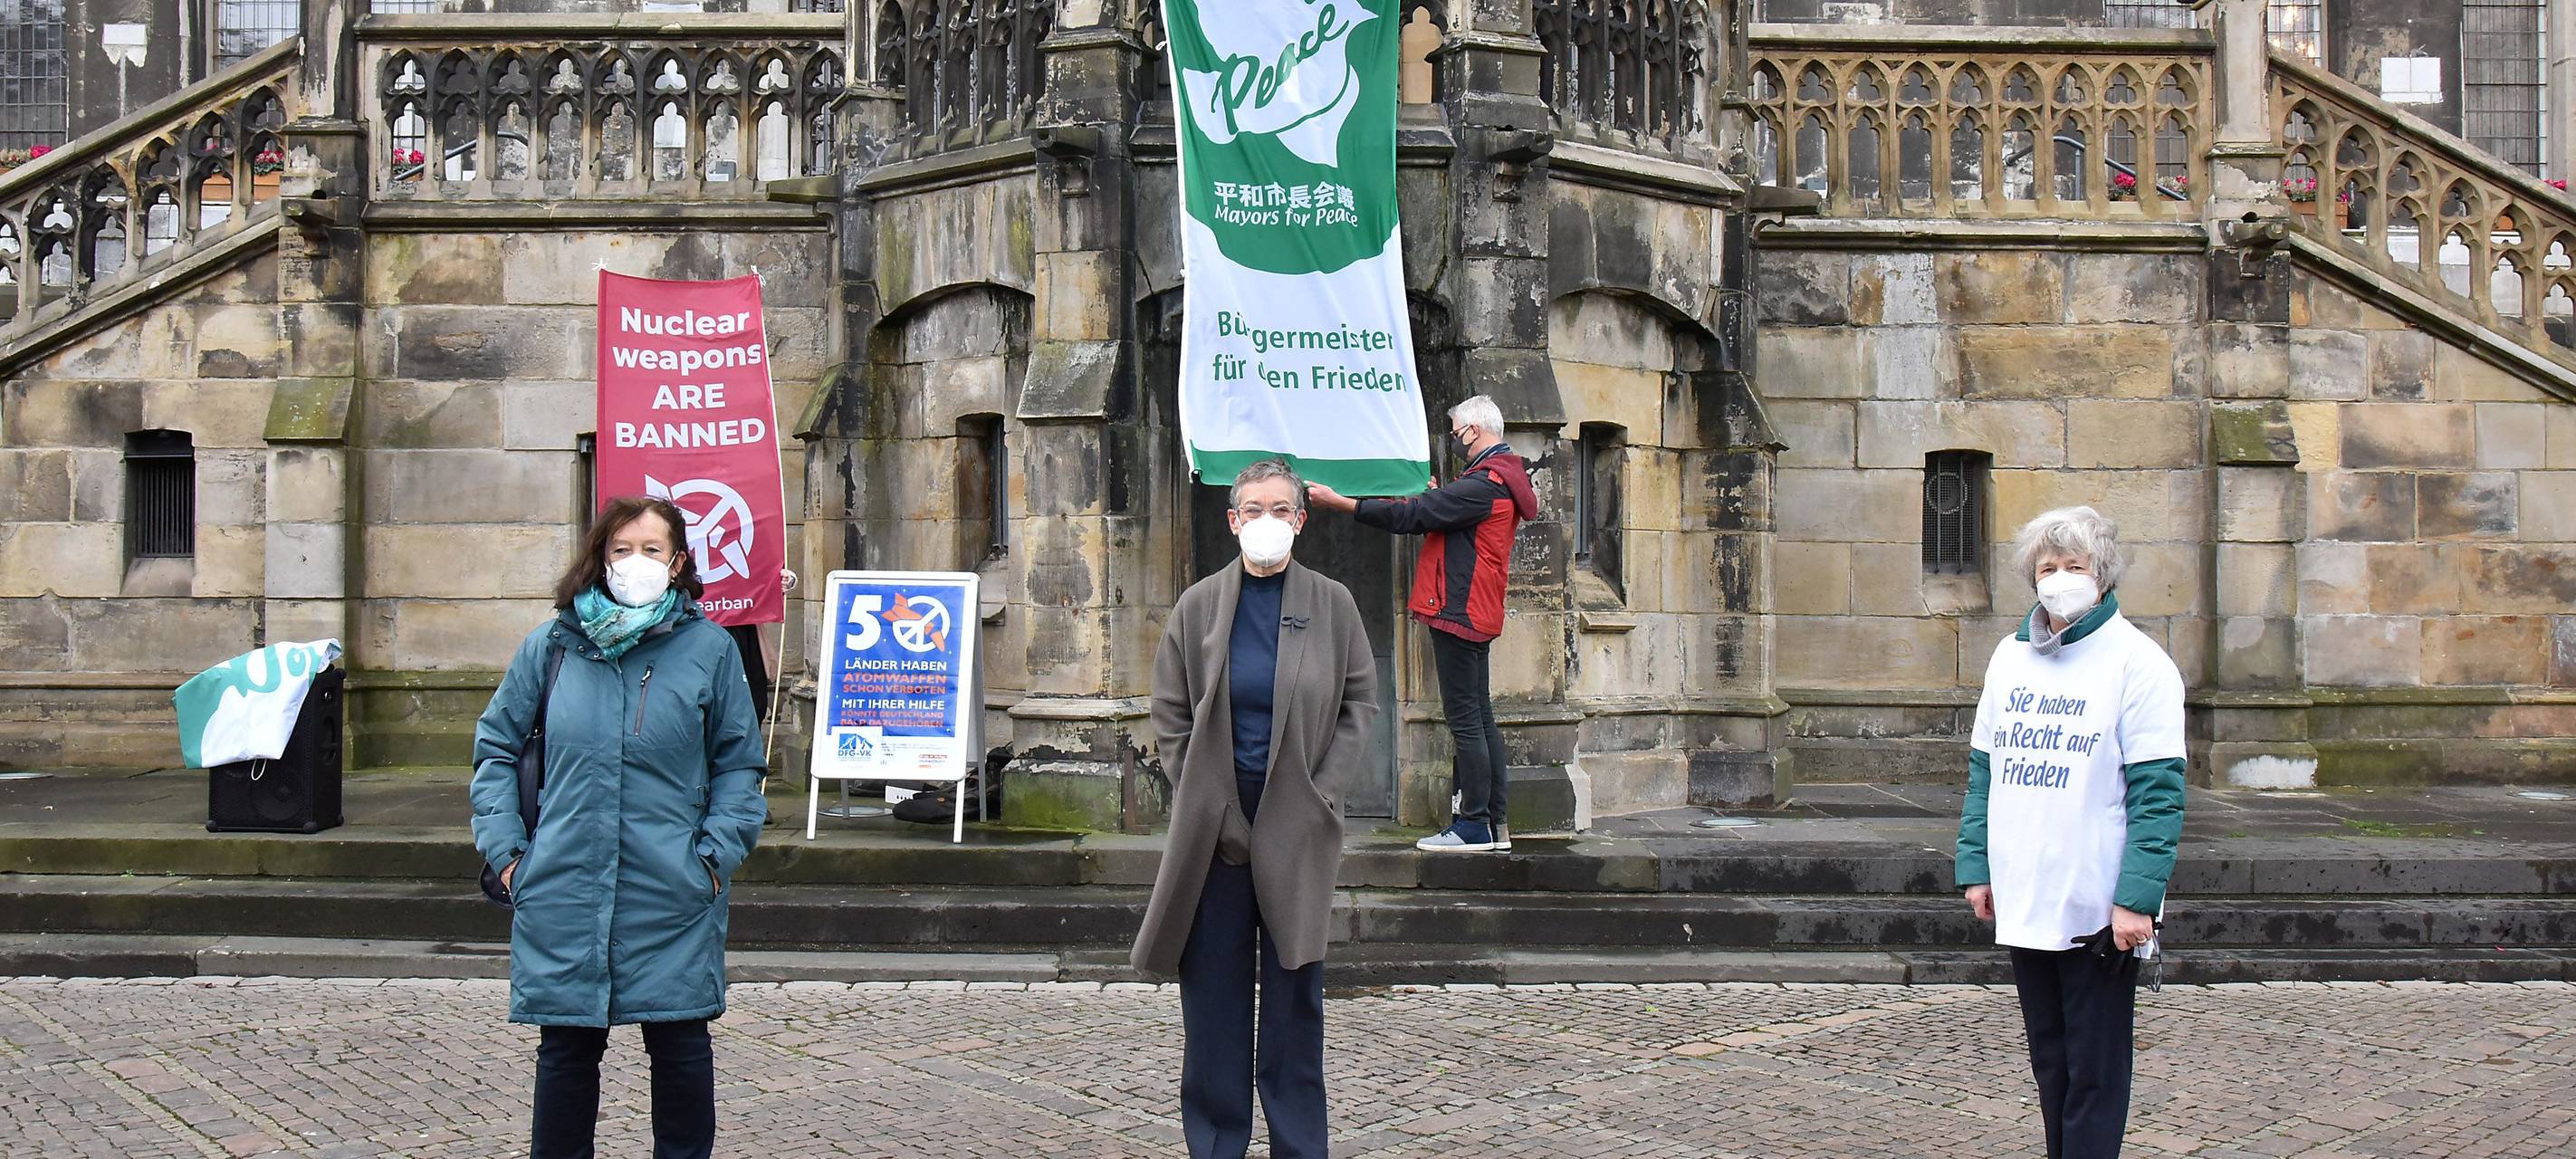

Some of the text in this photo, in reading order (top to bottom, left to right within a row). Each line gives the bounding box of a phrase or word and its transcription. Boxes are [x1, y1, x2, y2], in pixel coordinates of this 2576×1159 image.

[1211, 4, 1350, 135] Peace
[1214, 204, 1358, 227] Mayors for Peace
[621, 306, 750, 336] Nuclear
[1217, 311, 1393, 353] Bügermeister
[612, 342, 762, 376] weapons
[1212, 354, 1246, 381] für
[1312, 365, 1406, 392] Frieden
[651, 382, 726, 410] ARE
[615, 417, 766, 449] BANNED
[696, 597, 753, 612] earban
[843, 672, 947, 684] ATOMWAFFEN
[845, 657, 947, 671] LÄNDER HABEN
[842, 698, 945, 710] MIT IHRER HILFE
[843, 684, 946, 694] SCHON VERBOTEN
[2005, 686, 2086, 716] Sie haben
[1994, 722, 2101, 757] ein Recht auf
[2002, 757, 2070, 789] Frieden
